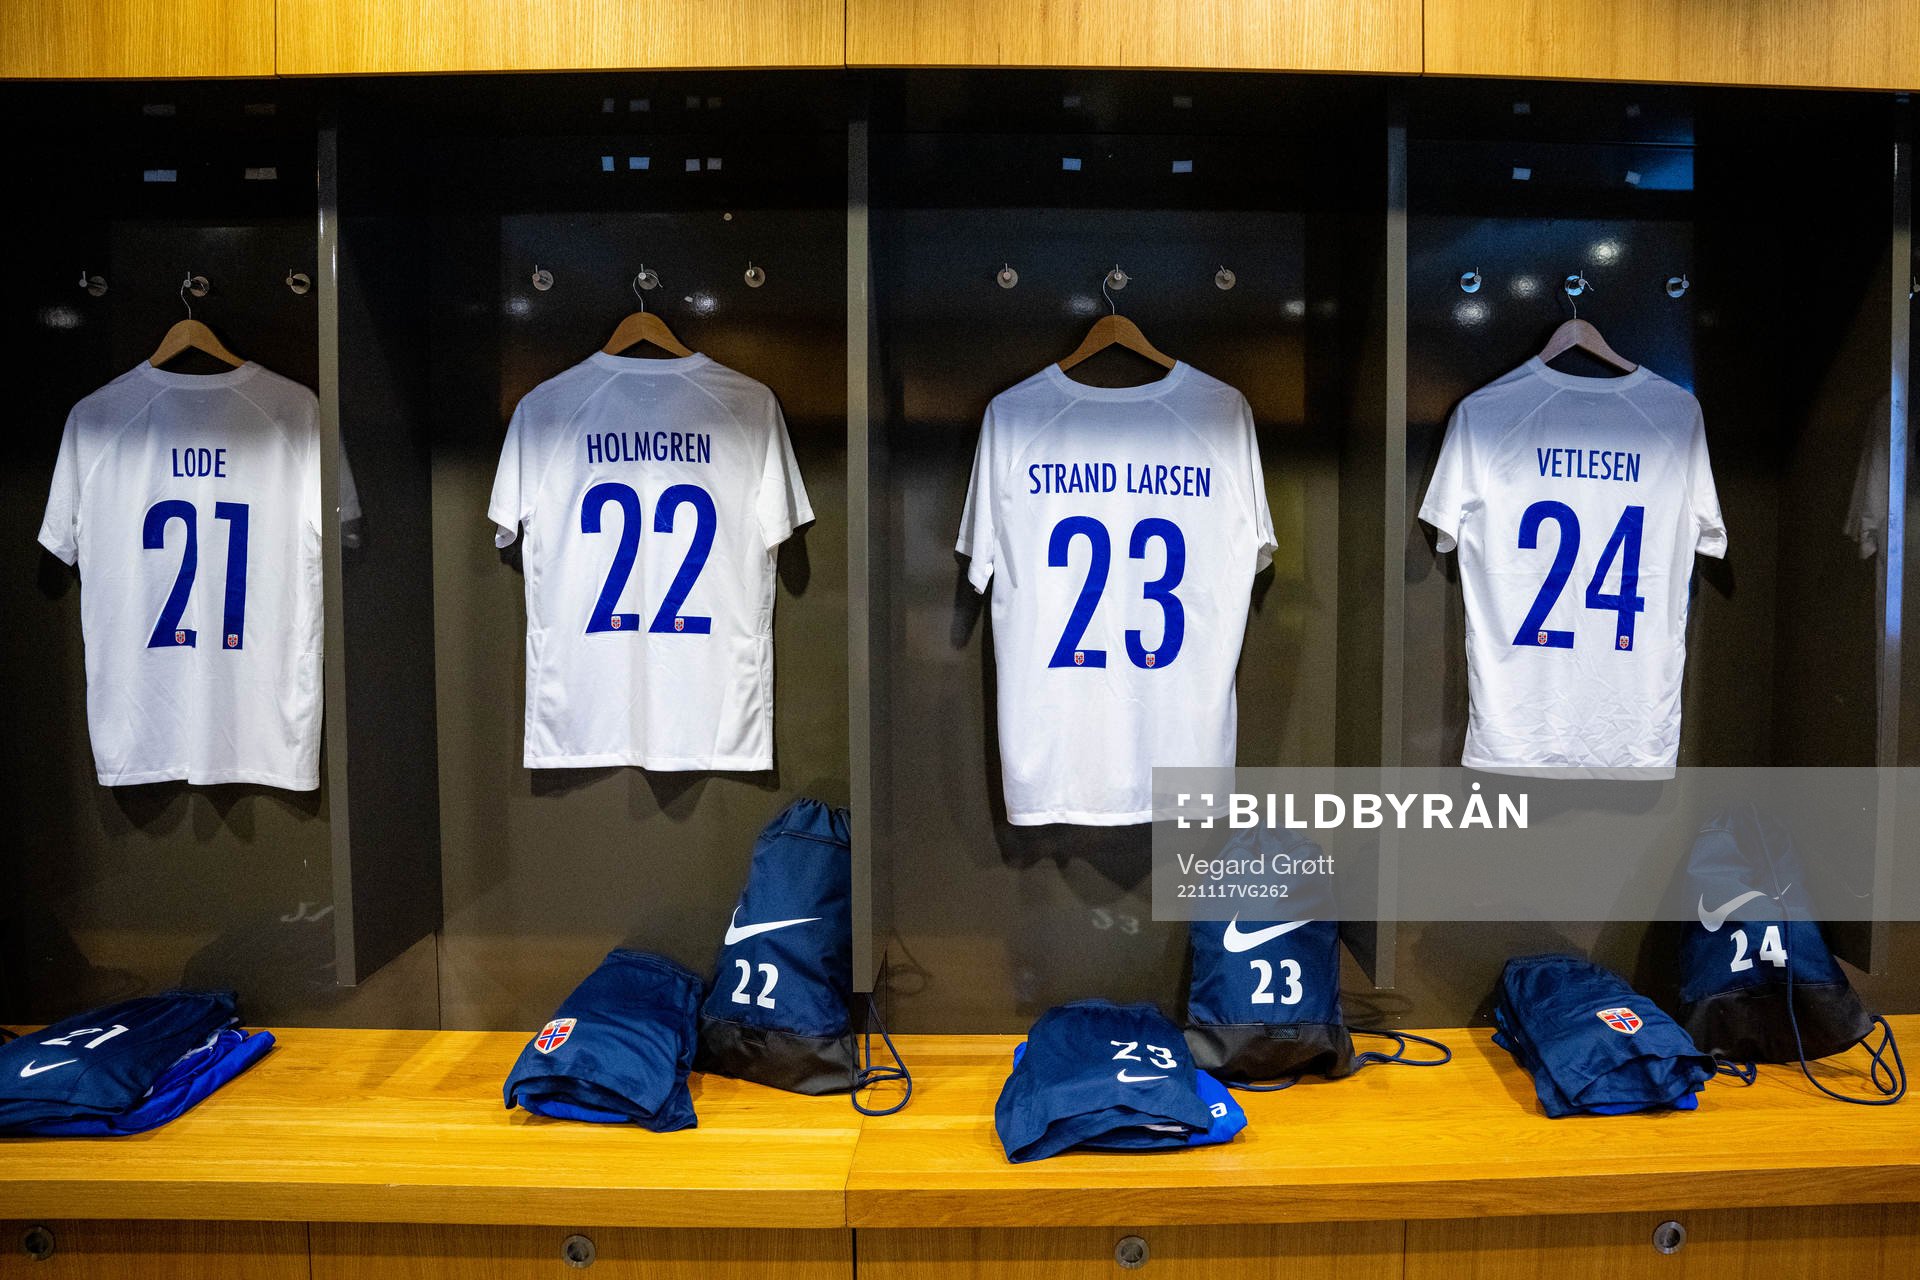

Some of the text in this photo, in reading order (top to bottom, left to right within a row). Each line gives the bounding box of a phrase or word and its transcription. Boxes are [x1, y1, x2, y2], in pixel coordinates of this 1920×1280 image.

[172, 447, 226, 478] LODE
[586, 431, 711, 463] HOLMGREN
[1537, 447, 1641, 482] VETLESEN
[1028, 463, 1211, 497] STRAND LARSEN
[143, 499, 249, 650] 21
[580, 482, 717, 634] 22
[1512, 500, 1645, 651] 24
[1048, 515, 1186, 669] 23
[1729, 925, 1788, 973] 24
[731, 959, 779, 1009] 22
[1250, 959, 1303, 1005] 23
[39, 1024, 129, 1050] 21
[1110, 1040, 1177, 1069] 23
